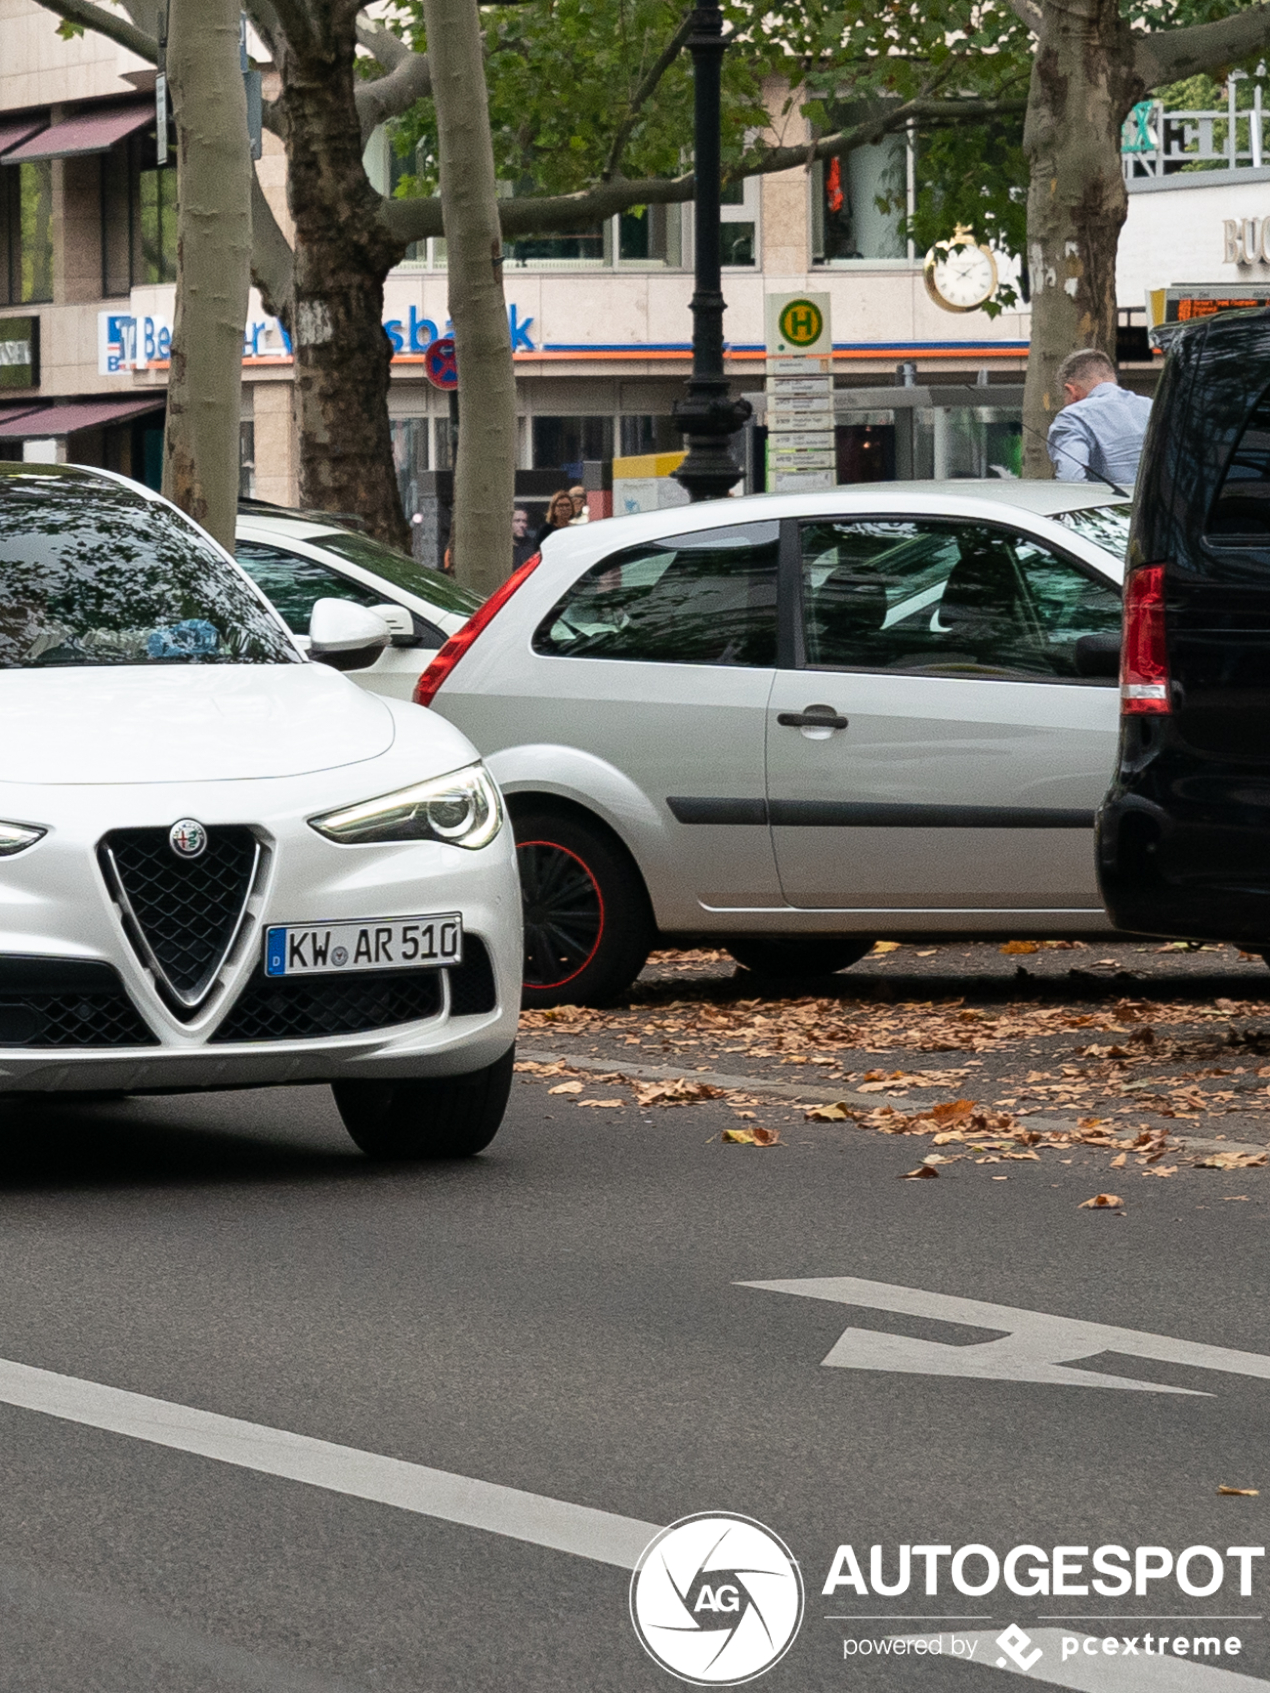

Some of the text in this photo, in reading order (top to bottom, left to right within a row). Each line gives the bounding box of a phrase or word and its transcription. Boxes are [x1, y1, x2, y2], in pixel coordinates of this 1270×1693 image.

[792, 311, 812, 336] H
[289, 923, 458, 968] KW AR 510
